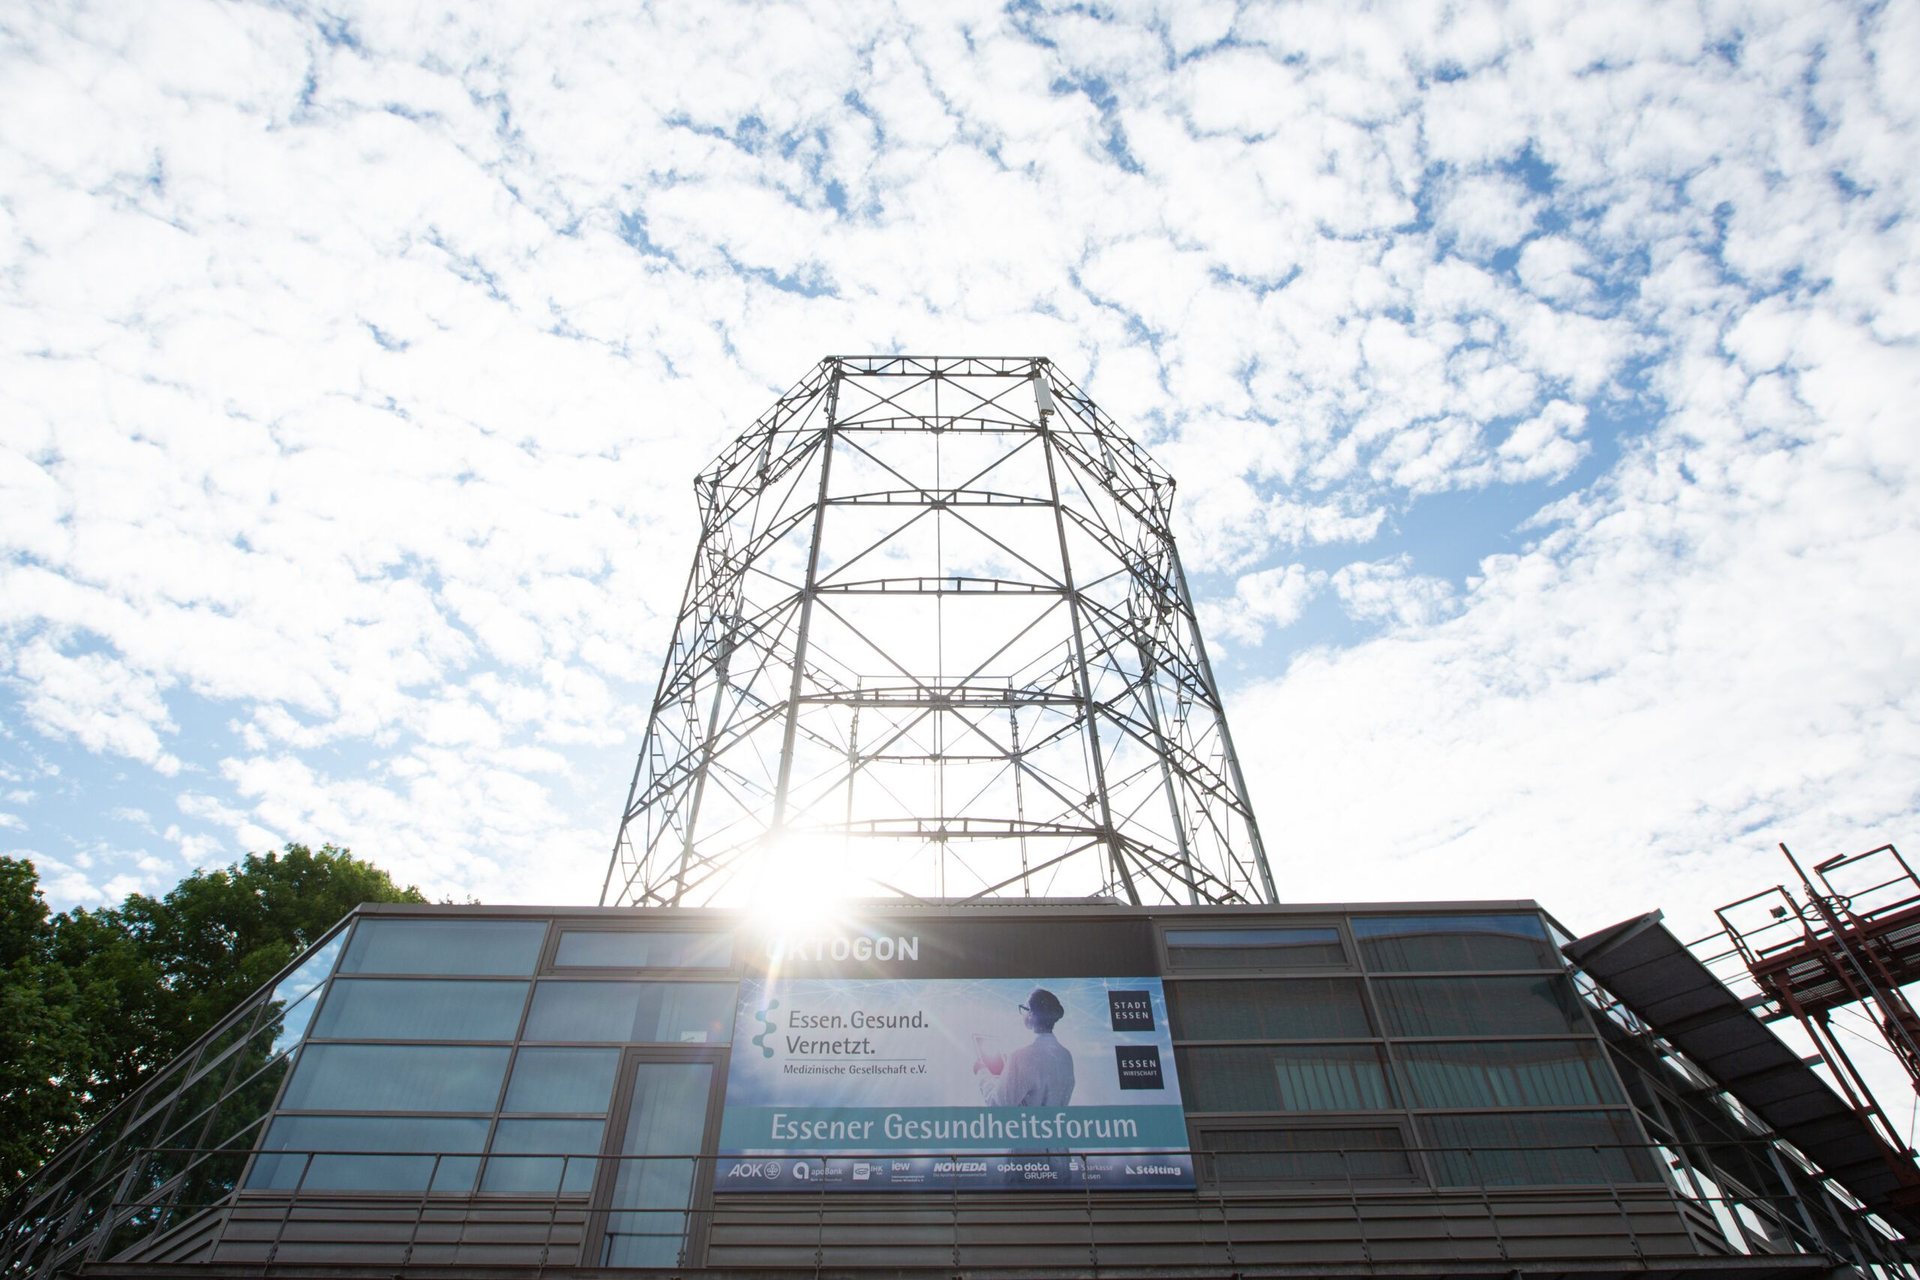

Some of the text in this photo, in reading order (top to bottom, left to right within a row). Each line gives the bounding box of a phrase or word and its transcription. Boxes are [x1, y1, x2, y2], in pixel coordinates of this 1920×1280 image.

[1114, 1001, 1147, 1009] STADT
[1115, 1011, 1149, 1019] ESSEN
[786, 1035, 875, 1054] Vernetzt.
[783, 1064, 927, 1075] Medizinische Gesellschaft e.V.
[1121, 1060, 1156, 1068] ESSEN
[771, 1113, 1138, 1140] Essener Gesundheitsforum
[728, 1163, 762, 1177] AOK
[933, 1162, 987, 1172] NOWEDA
[997, 1162, 1050, 1173] opta data
[1136, 1164, 1181, 1176] Stölting
[1024, 1172, 1058, 1180] GRUPPE
